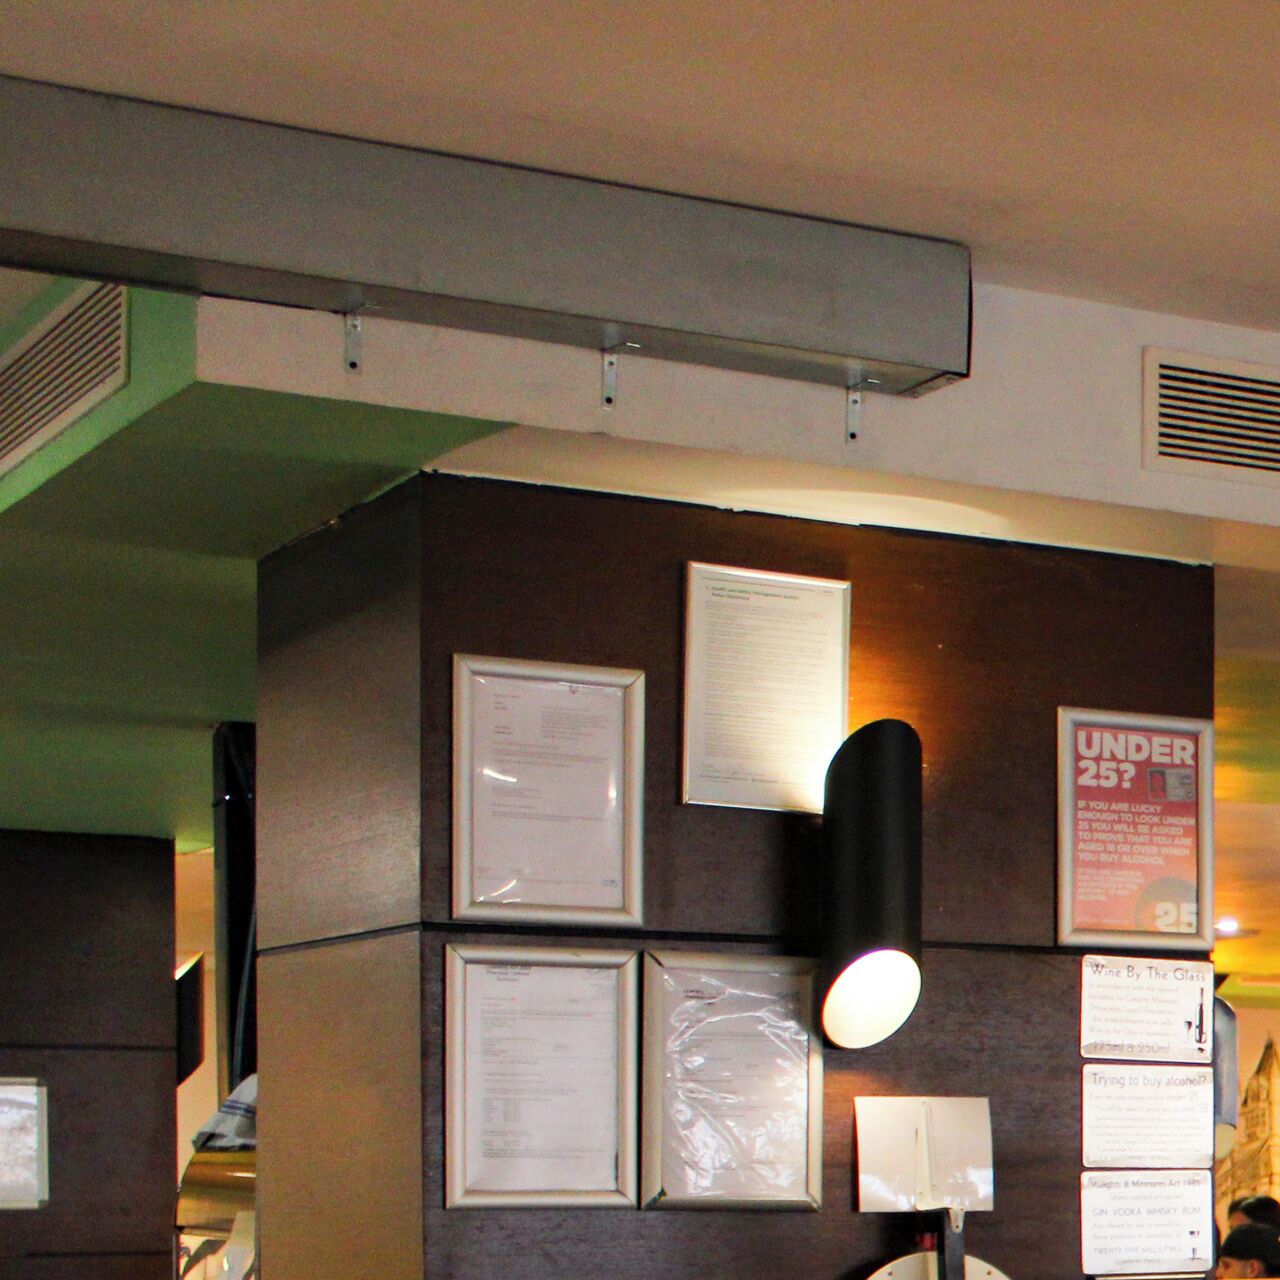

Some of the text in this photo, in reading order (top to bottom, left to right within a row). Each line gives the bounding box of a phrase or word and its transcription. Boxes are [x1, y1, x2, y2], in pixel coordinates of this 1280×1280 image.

[1077, 731, 1195, 766] UNDER
[1077, 760, 1136, 789] 25?
[1089, 801, 1108, 810] YOU
[1110, 802, 1129, 811] ARE
[1131, 803, 1162, 813] LUCKY
[1077, 811, 1196, 826] ENOUGH TO LOOK UNDER
[1092, 822, 1111, 831] YOU
[1113, 824, 1136, 833] WILL
[1152, 826, 1184, 835] ASKED
[1078, 831, 1194, 846] TO PROVE THAT YOU ARE
[1155, 901, 1197, 934] 25
[1090, 962, 1206, 982] Wine By The Glass
[1091, 1072, 1207, 1088] Trying to buy alcohol?
[1092, 1206, 1201, 1217] GIN VODKA WHISKY RUM
